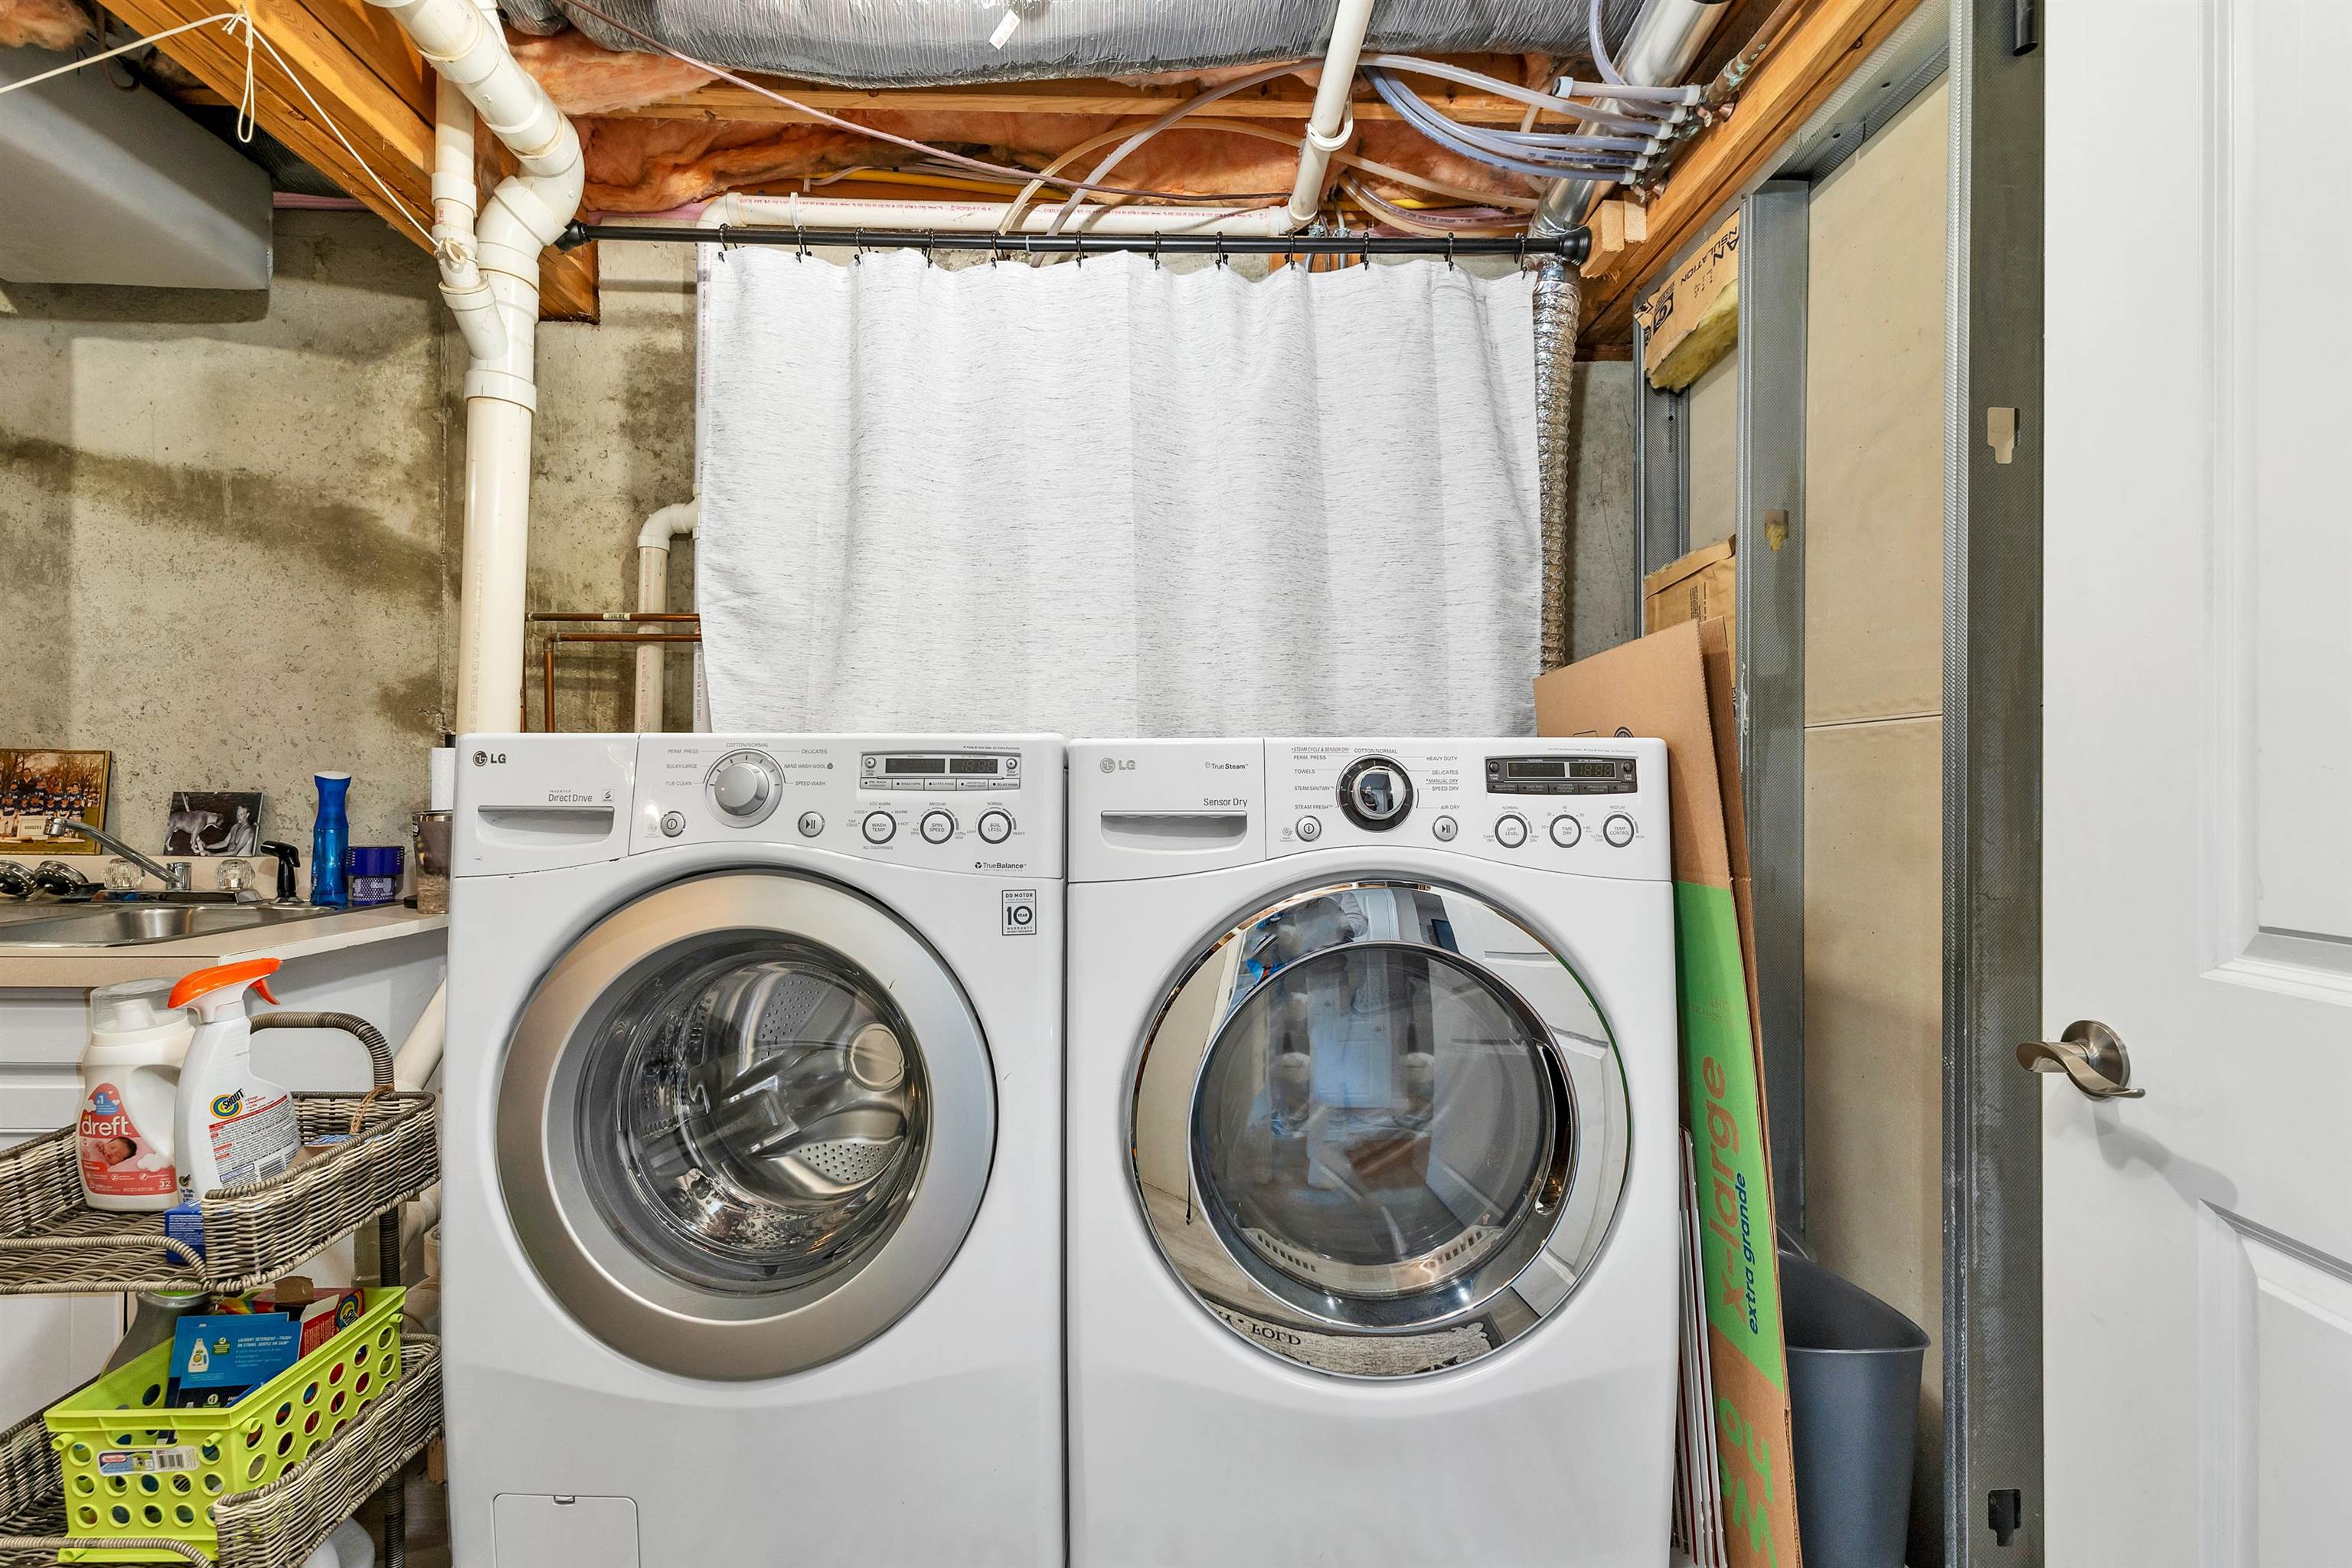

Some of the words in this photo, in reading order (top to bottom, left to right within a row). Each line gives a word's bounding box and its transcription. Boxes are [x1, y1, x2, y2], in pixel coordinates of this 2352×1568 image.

[491, 753, 506, 764] LG
[1119, 760, 1136, 770] LG
[548, 793, 571, 802] Direct
[572, 793, 593, 802] Drive
[1204, 798, 1231, 806] Sensor
[1233, 798, 1248, 808] Dry
[1006, 905, 1033, 926] 10
[222, 1087, 245, 1110] SHOUT
[81, 1116, 129, 1136] dreft
[158, 1180, 172, 1188] 32
[1702, 1055, 1746, 1323] x-large
[1736, 1172, 1756, 1266] grande
[1743, 1269, 1759, 1335] extra
